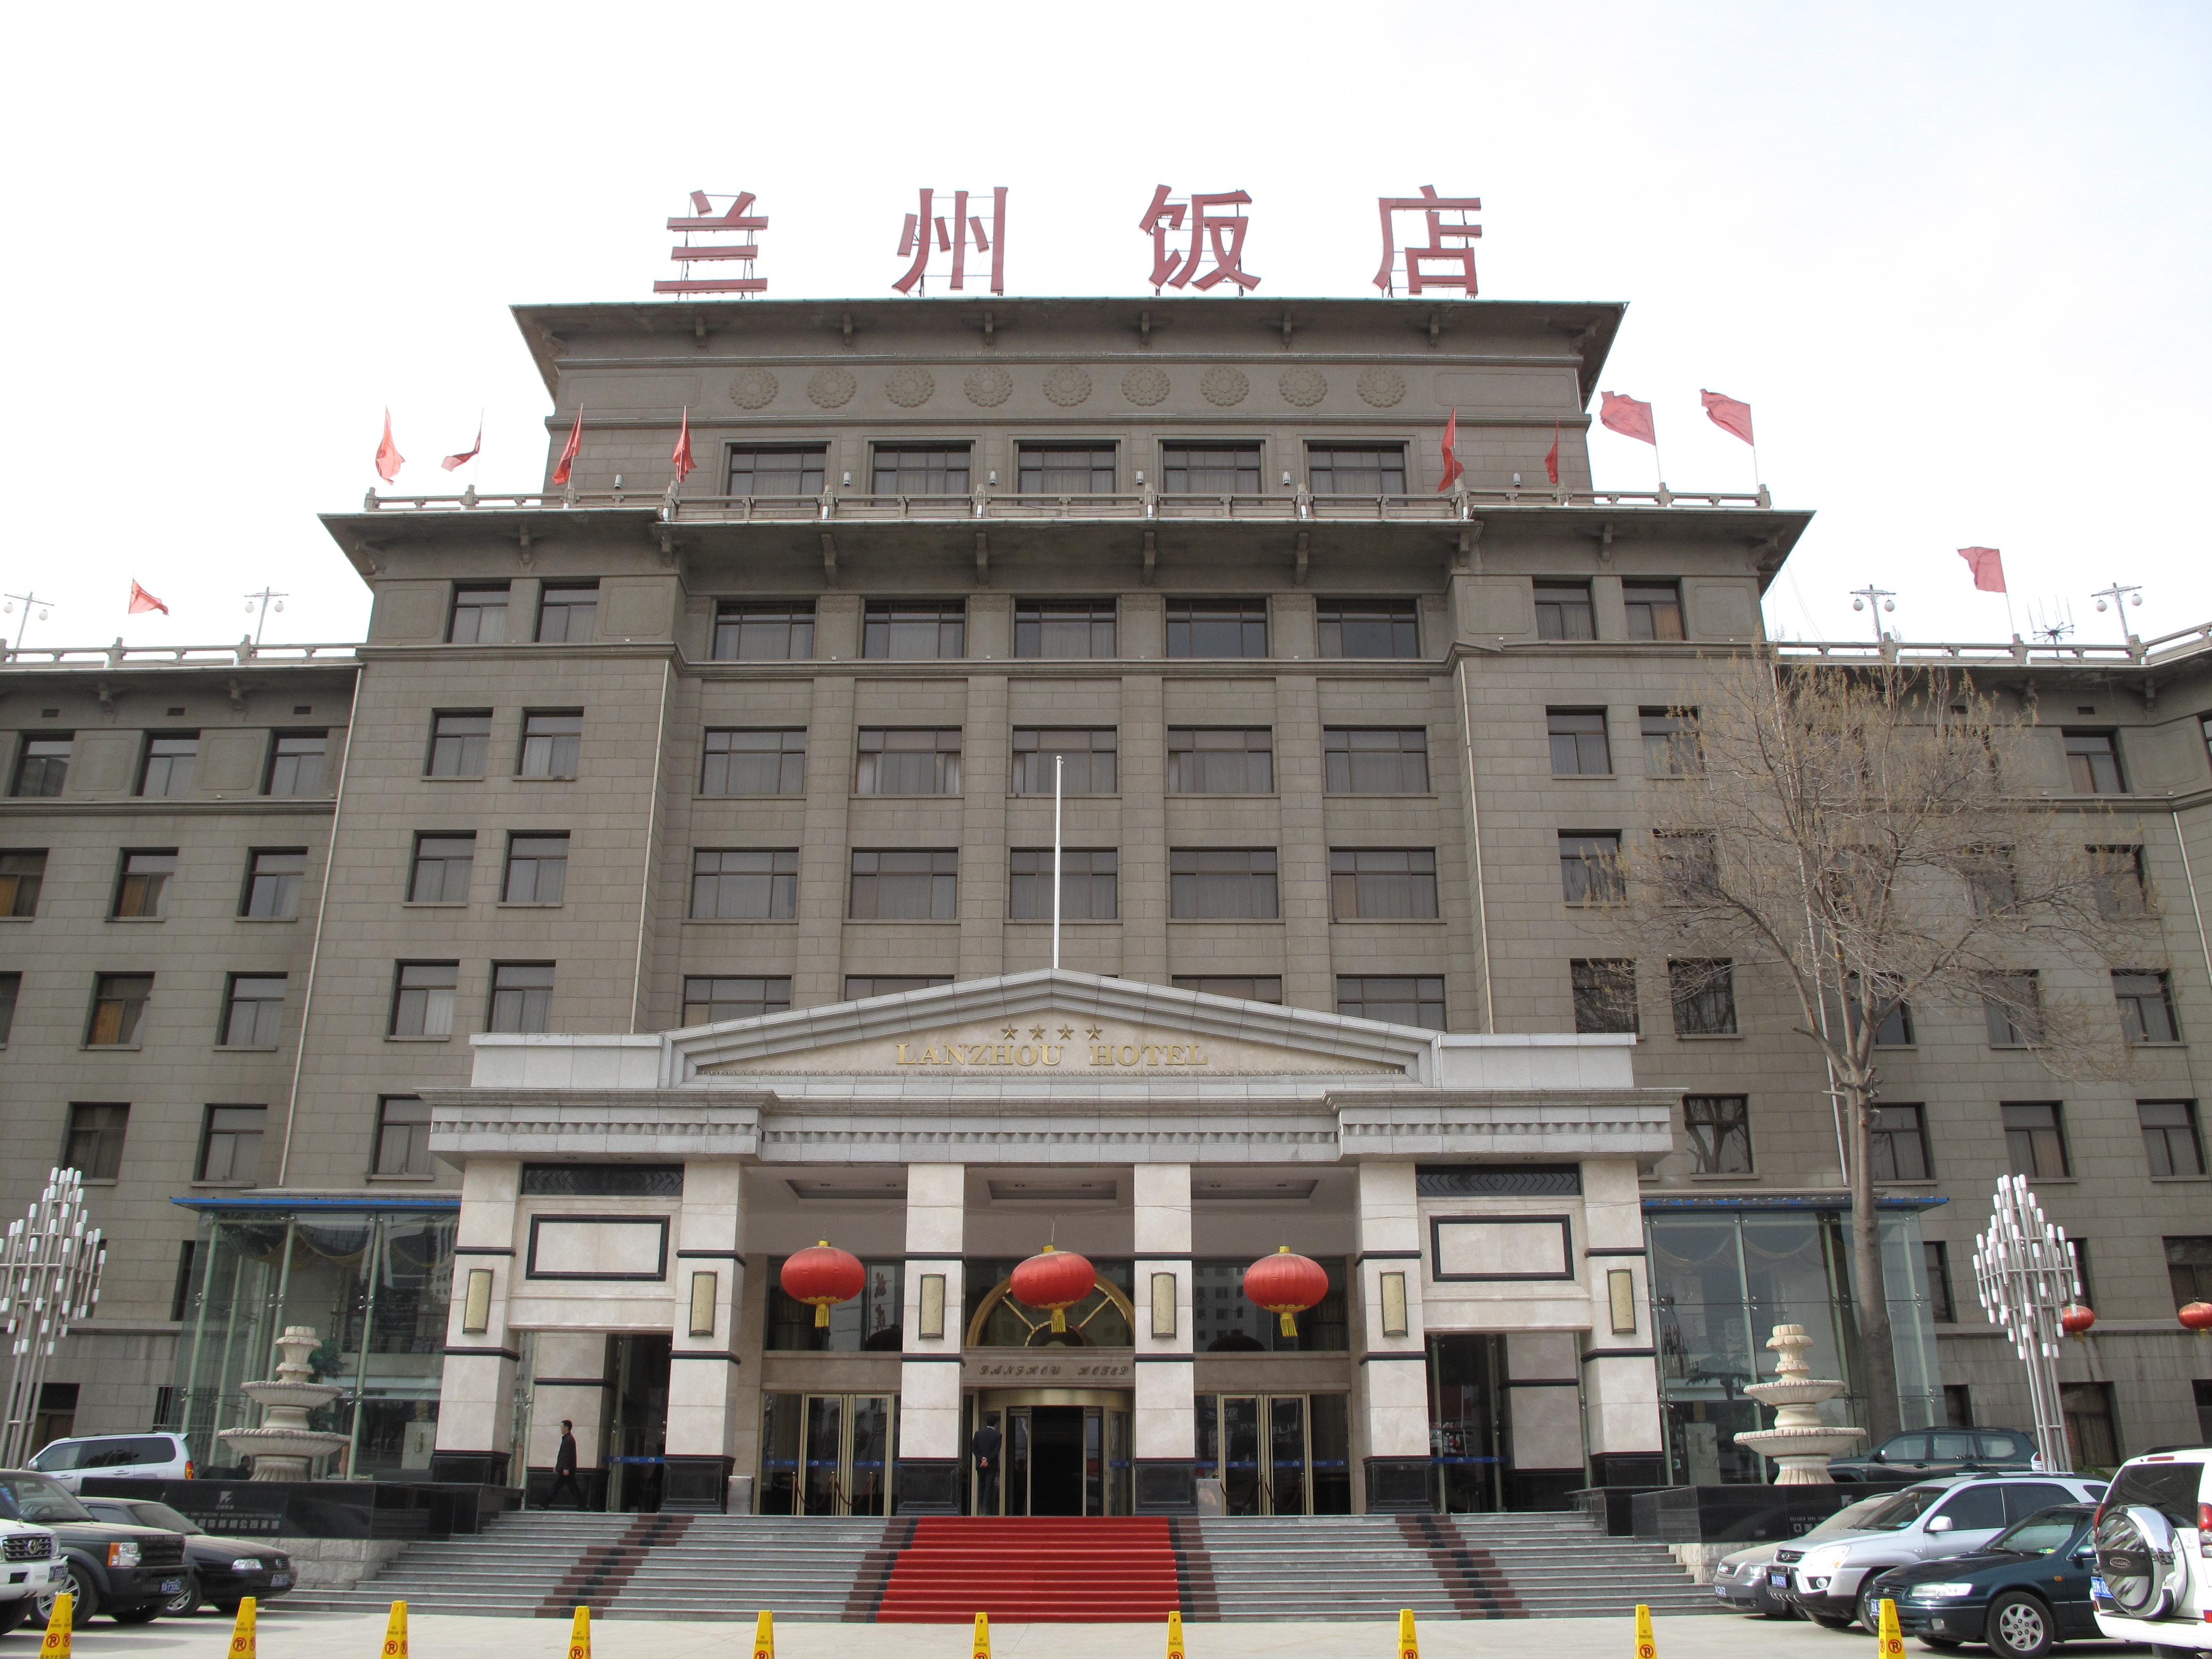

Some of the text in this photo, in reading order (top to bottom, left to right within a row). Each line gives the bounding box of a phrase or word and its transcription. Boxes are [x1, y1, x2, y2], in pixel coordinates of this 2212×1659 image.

[653, 184, 1482, 296] 兰州饭店
[896, 1043, 1208, 1065] LANZHOU HOTEL
[979, 1365, 1061, 1376] LANZHOU
